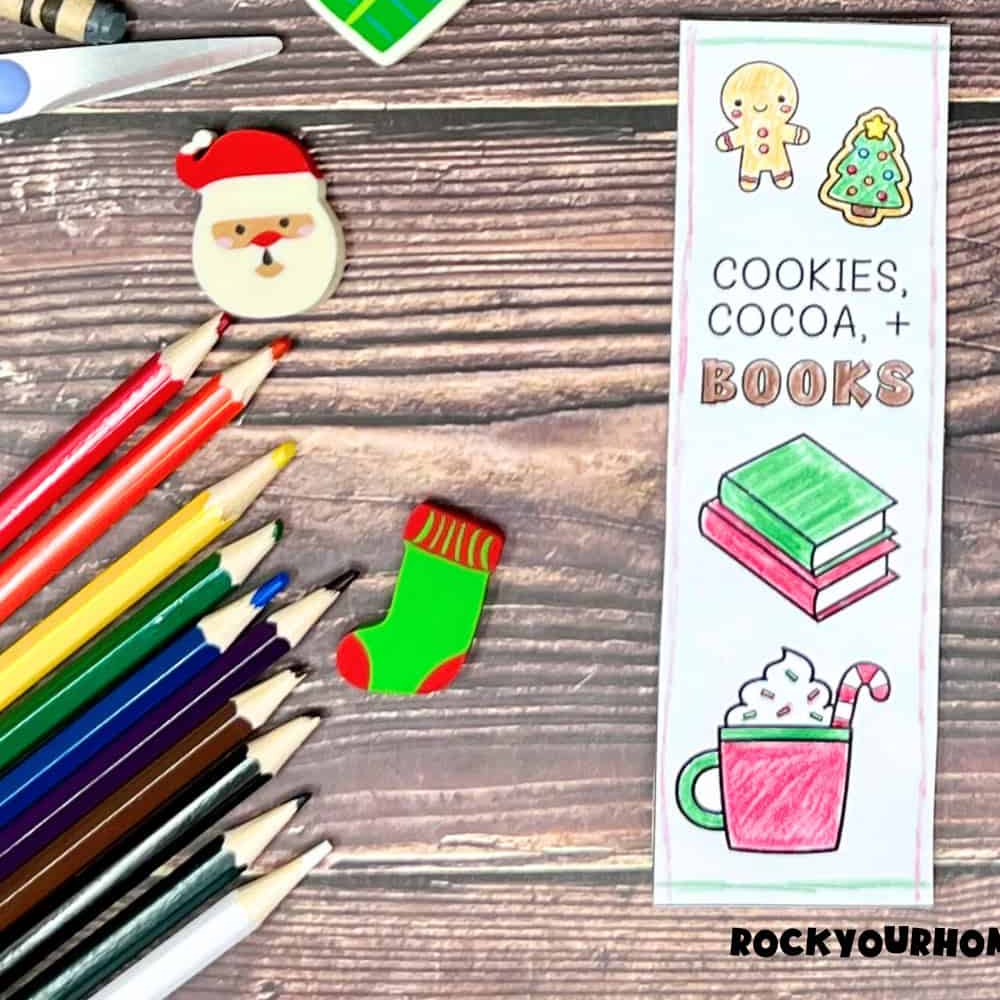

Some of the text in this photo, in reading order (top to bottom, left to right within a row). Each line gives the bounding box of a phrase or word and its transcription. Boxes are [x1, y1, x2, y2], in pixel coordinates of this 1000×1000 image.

[712, 256, 908, 299] COOKIES,
[707, 302, 868, 344] COCOA,
[700, 357, 915, 409] BOOKS
